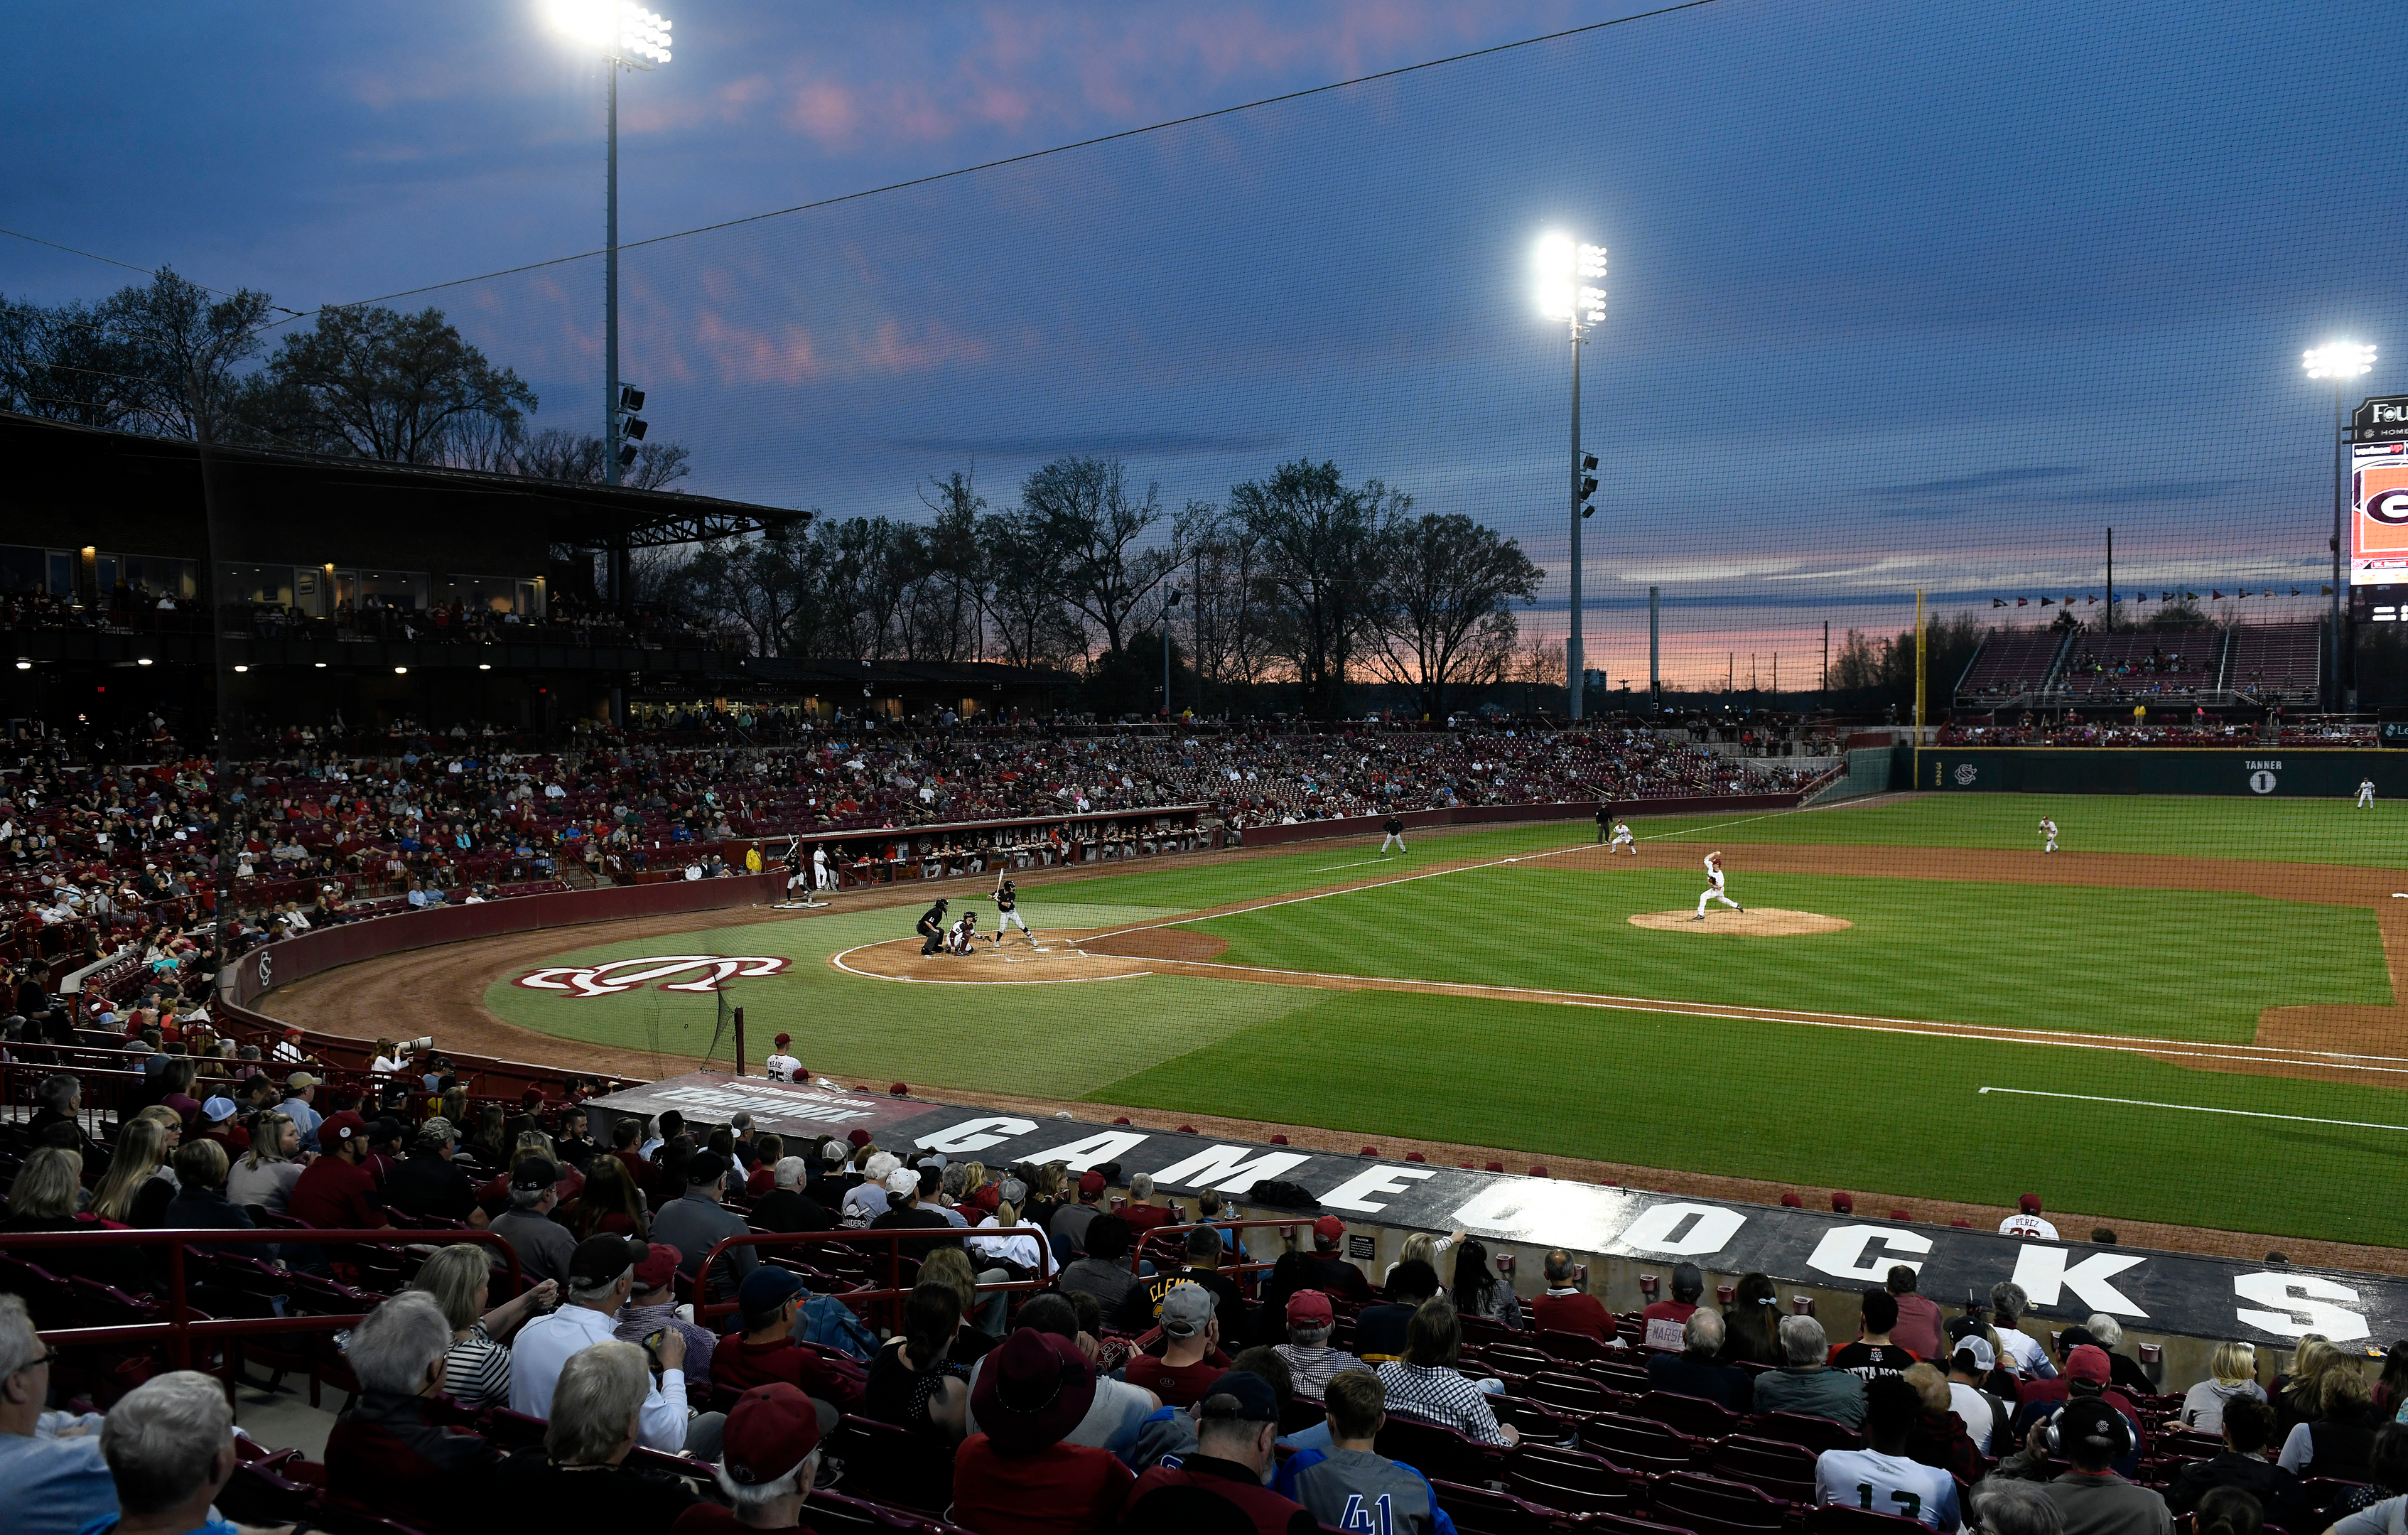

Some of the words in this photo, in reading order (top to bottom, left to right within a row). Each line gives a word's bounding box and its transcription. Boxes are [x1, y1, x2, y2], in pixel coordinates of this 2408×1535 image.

[2245, 760, 2282, 770] TANNER
[2258, 773, 2266, 790] 1
[649, 1087, 877, 1123] TERMINIX
[719, 1081, 876, 1108] TrustTerminix.com
[2016, 1218, 2039, 1228] PEREZ
[1339, 1493, 1393, 1535] 41
